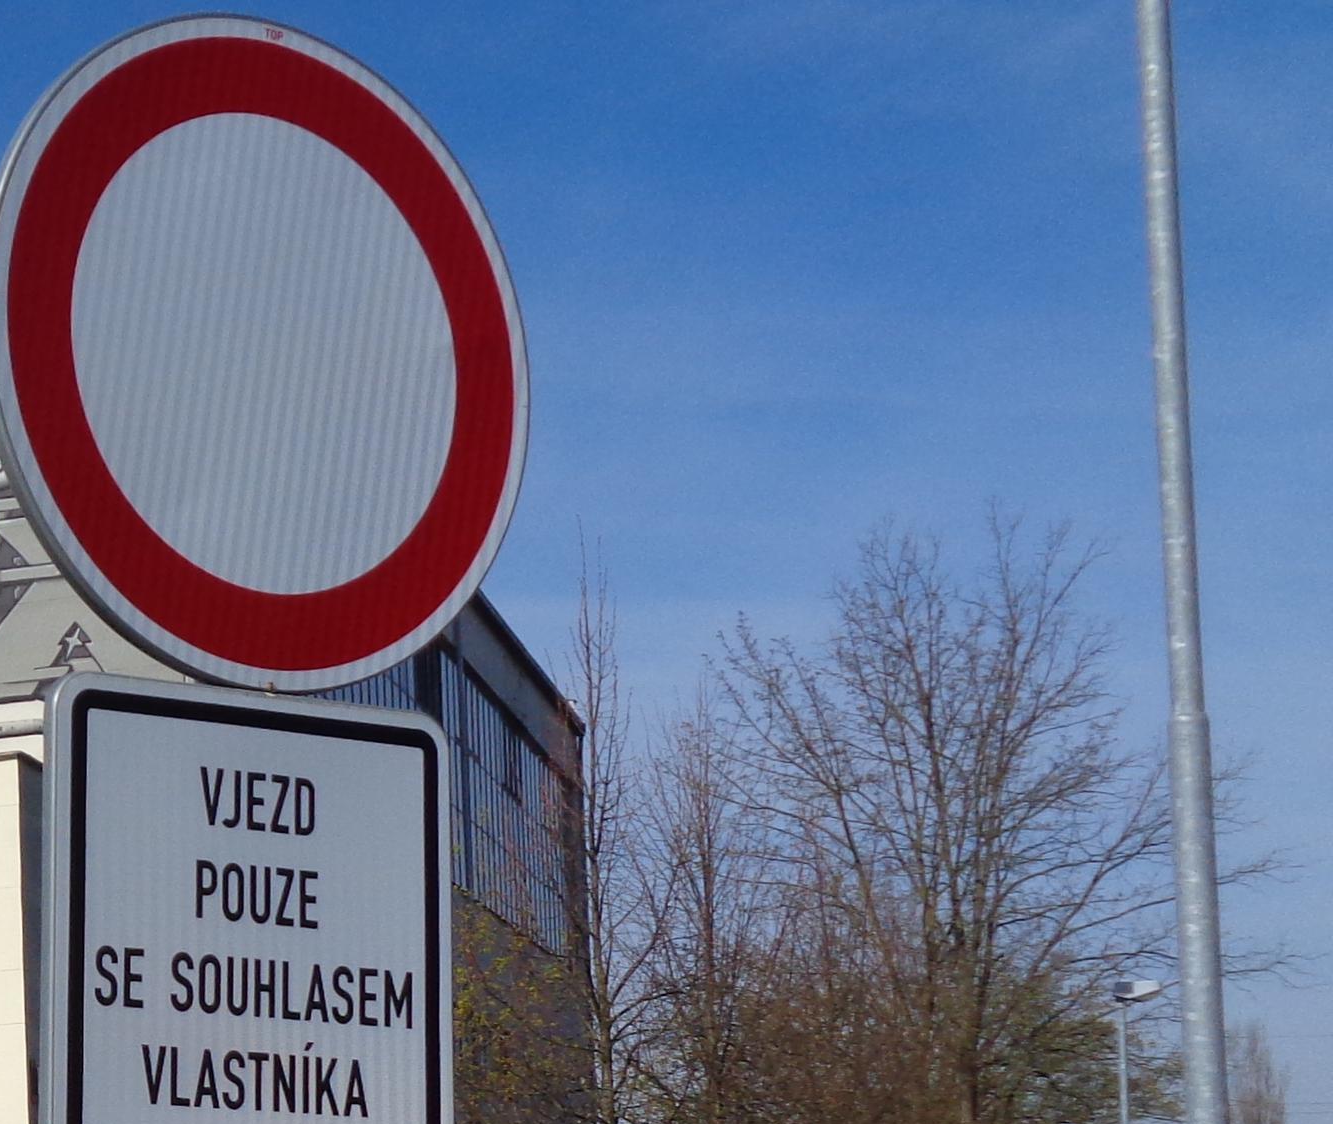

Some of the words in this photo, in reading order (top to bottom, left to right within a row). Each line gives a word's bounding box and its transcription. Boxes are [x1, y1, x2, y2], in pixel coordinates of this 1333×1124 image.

[200, 766, 316, 836] VJEZD
[195, 860, 319, 929] POUZE
[94, 945, 145, 1009] SE
[170, 952, 414, 1029] SOUHLASEM
[141, 1042, 369, 1118] VLASTNÍKA
